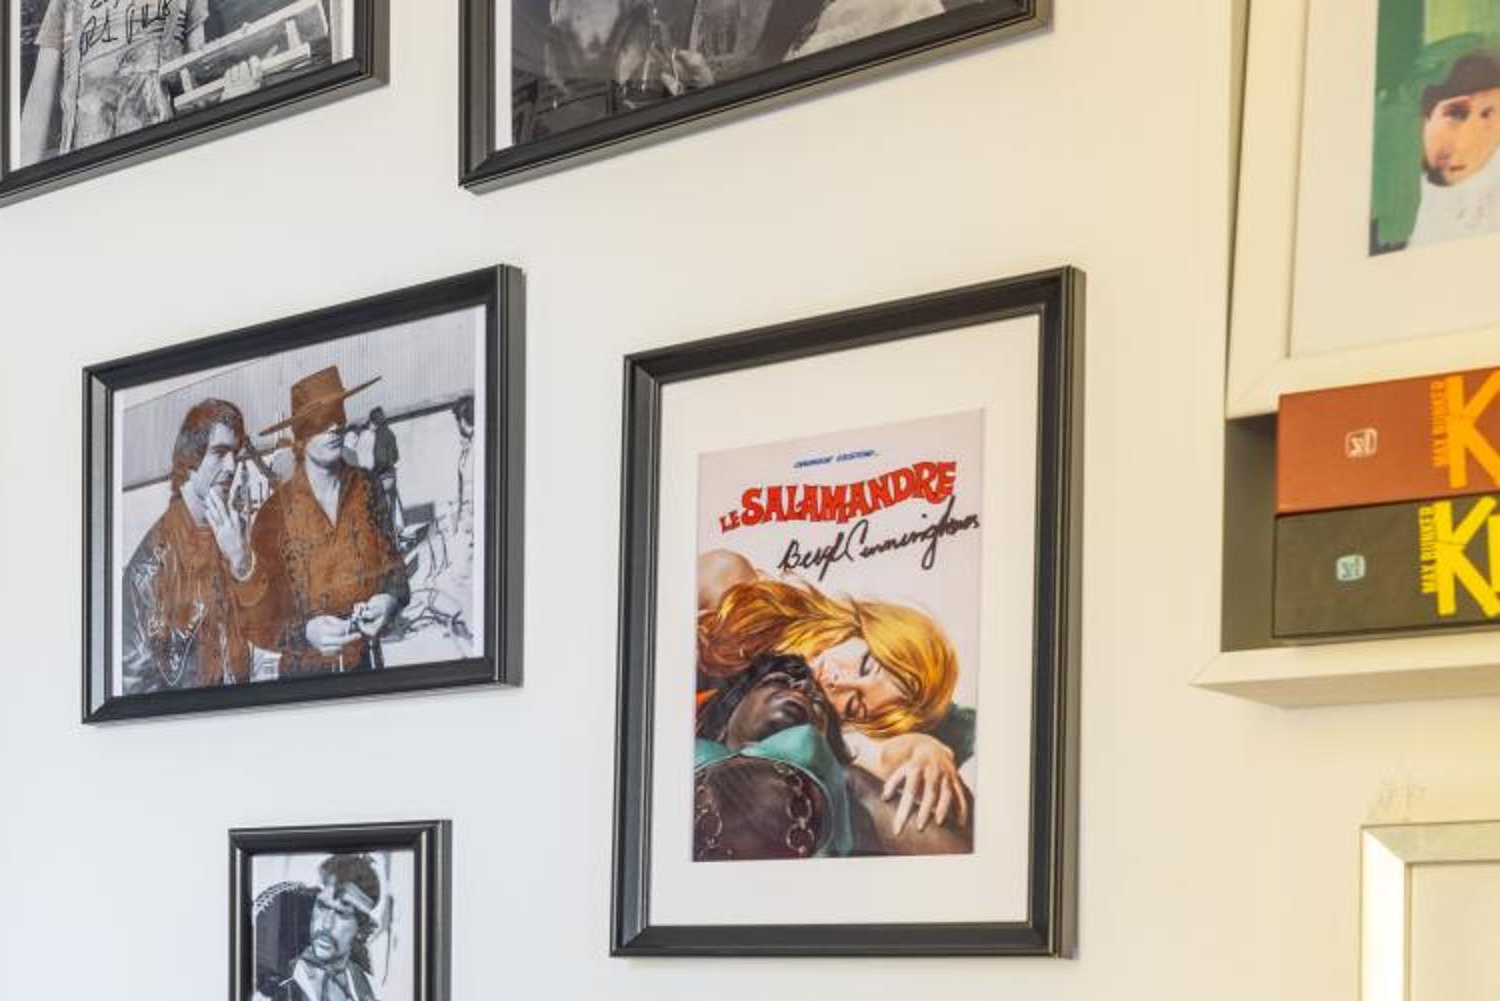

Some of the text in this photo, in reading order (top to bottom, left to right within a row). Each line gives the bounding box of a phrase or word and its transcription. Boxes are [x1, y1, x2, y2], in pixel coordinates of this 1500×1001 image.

[719, 461, 957, 534] LE SALAMANDRE
[1432, 495, 1500, 618] K
